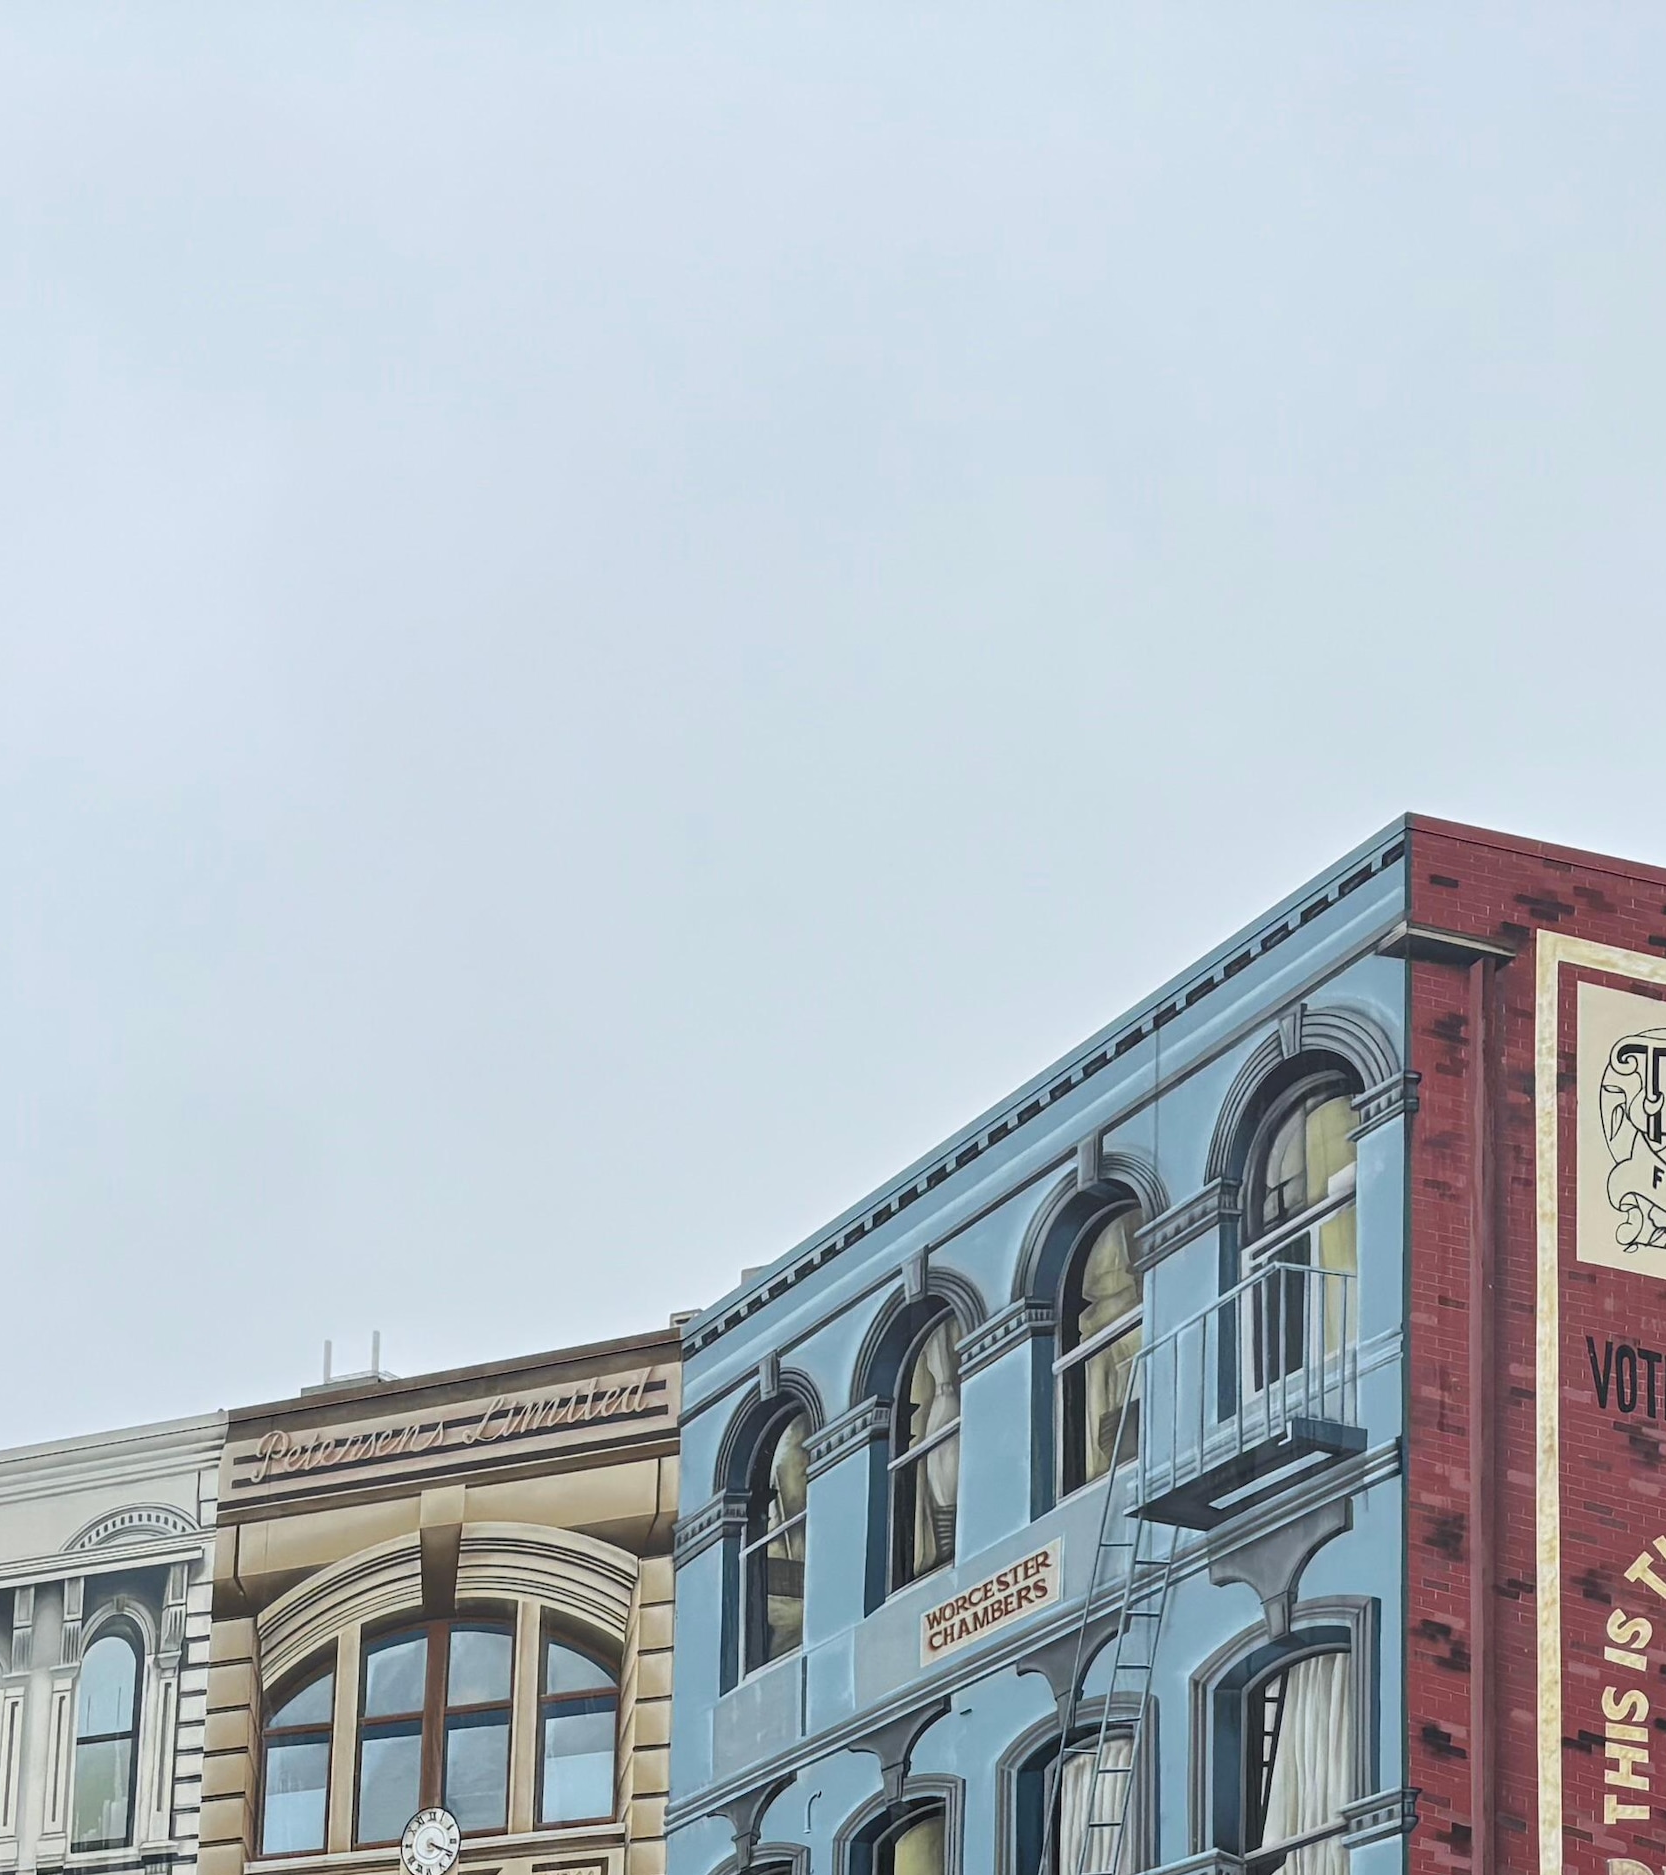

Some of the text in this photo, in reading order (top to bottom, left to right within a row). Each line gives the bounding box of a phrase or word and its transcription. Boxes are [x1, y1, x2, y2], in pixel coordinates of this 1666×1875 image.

[462, 1366, 653, 1445] Limited
[925, 1549, 1052, 1631] WORCESTER
[927, 1579, 1048, 1652] CHAMBERS
[1606, 1608, 1655, 1671] IS
[1601, 1688, 1653, 1824] THIS
